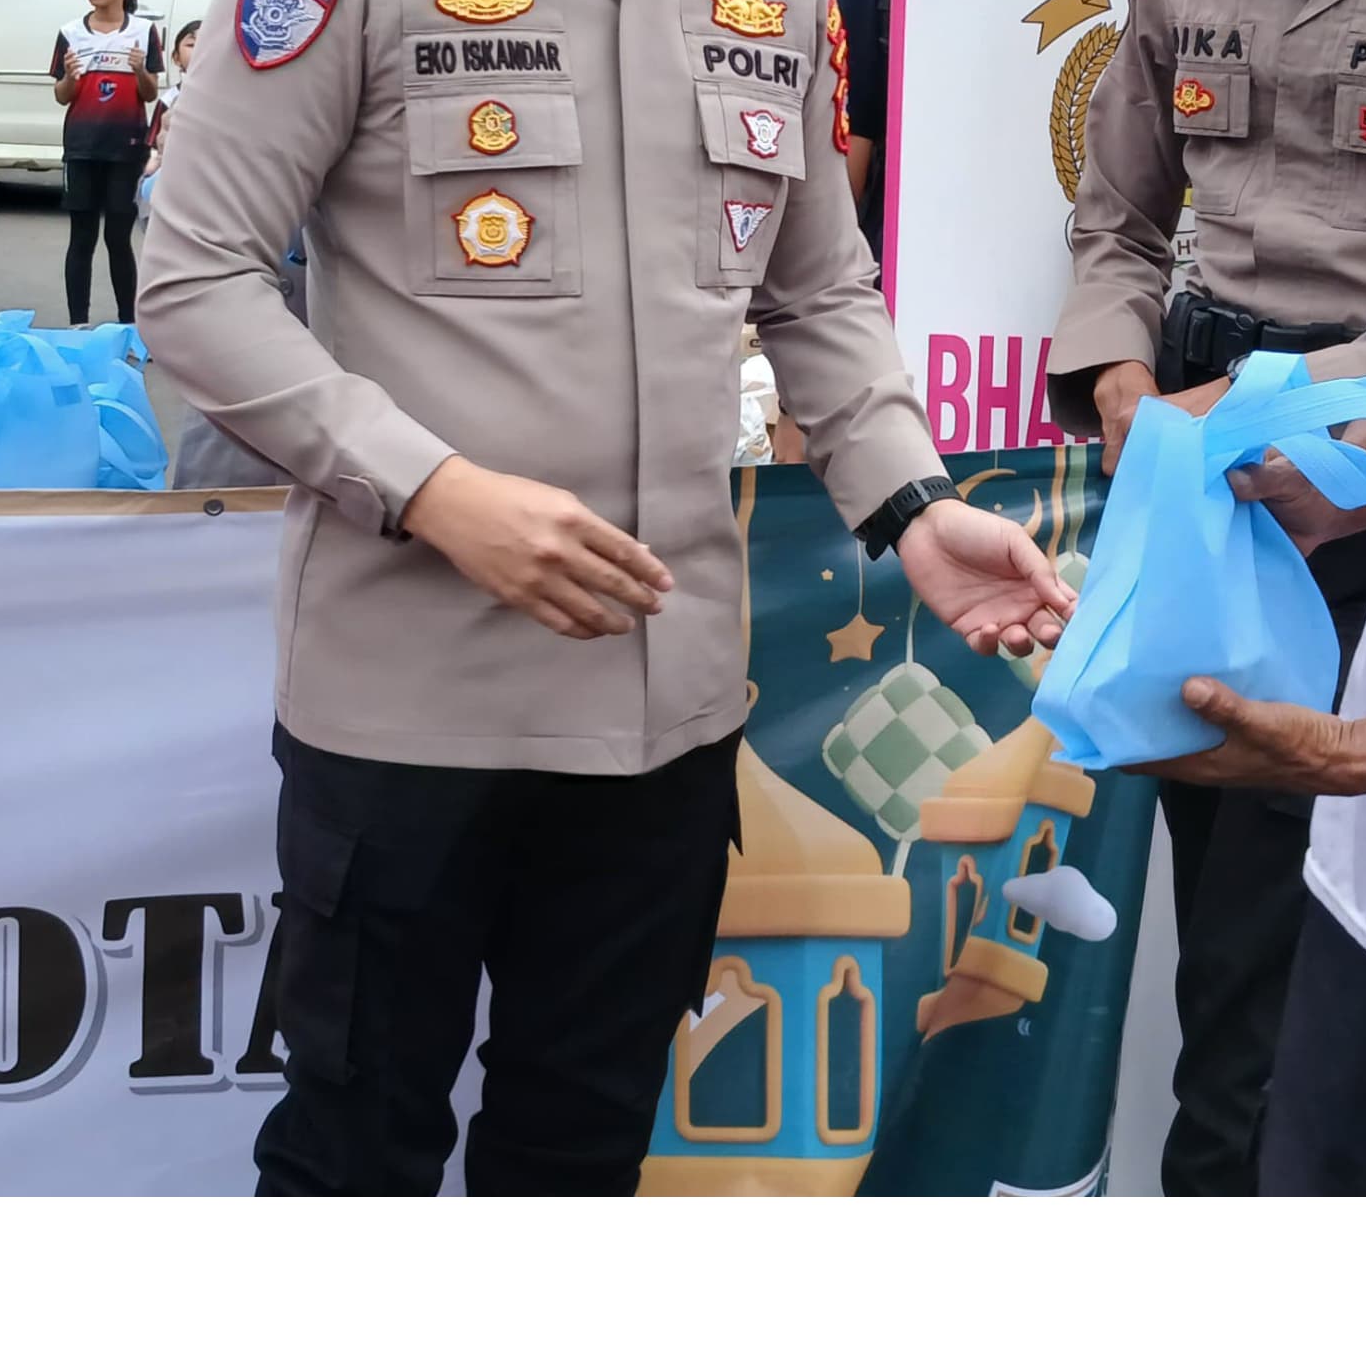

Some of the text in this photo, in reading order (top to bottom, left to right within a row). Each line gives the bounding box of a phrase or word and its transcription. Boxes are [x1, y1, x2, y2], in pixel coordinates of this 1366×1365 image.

[415, 39, 561, 75] EKO ISKANDAR
[703, 44, 798, 89] POLRI
[928, 333, 1055, 453] BHA
